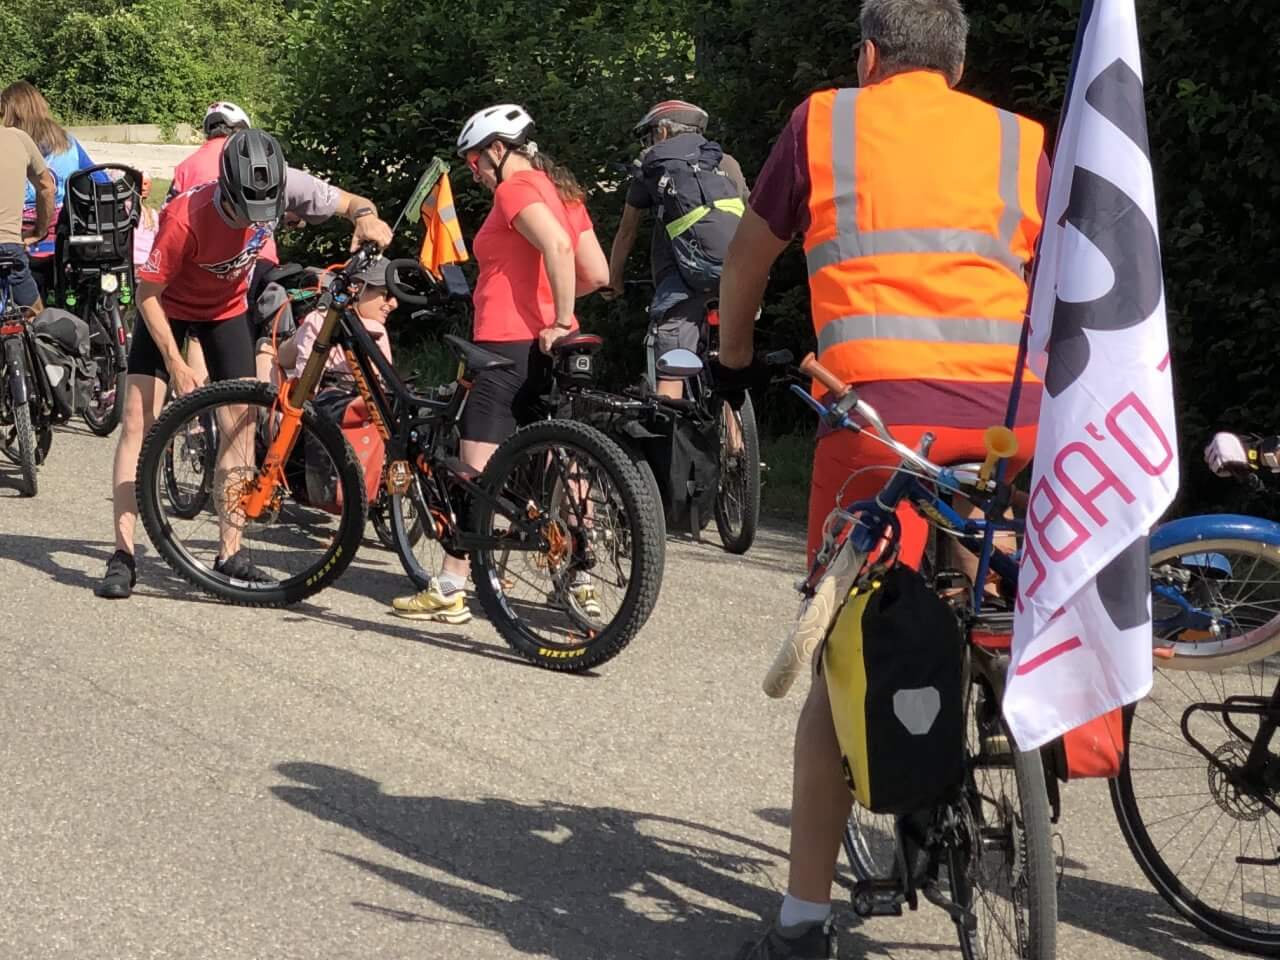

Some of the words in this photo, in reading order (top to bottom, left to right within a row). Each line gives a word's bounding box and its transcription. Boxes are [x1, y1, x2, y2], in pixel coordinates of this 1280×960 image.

[345, 349, 371, 401] SANTA
[366, 400, 390, 441] CRUZ
[305, 544, 343, 587] MAXXIS
[538, 647, 587, 658] MAXXIS
